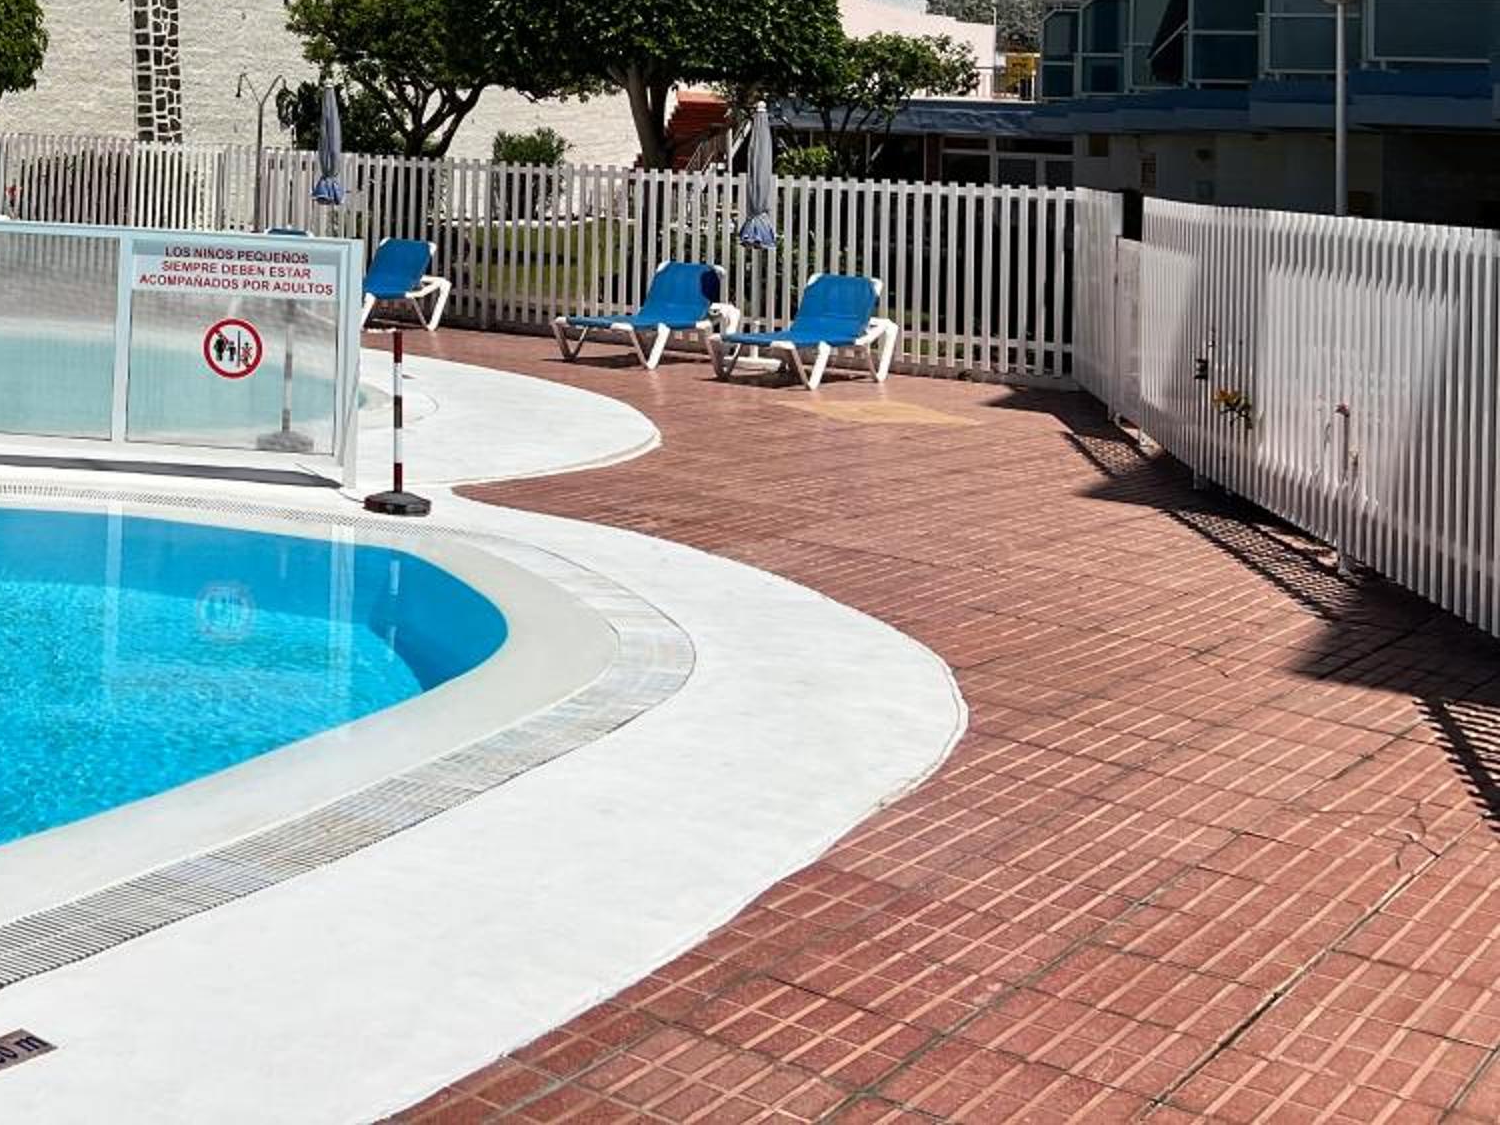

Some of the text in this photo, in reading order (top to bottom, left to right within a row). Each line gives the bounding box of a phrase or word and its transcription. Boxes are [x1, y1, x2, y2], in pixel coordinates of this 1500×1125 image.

[164, 246, 191, 258] LOS
[237, 249, 309, 264] PEQUEÑOS
[161, 260, 311, 279] SIEMPRE DEBEN ESTAR
[139, 274, 334, 296] ACOMPAÑADOS POR ADULTOS
